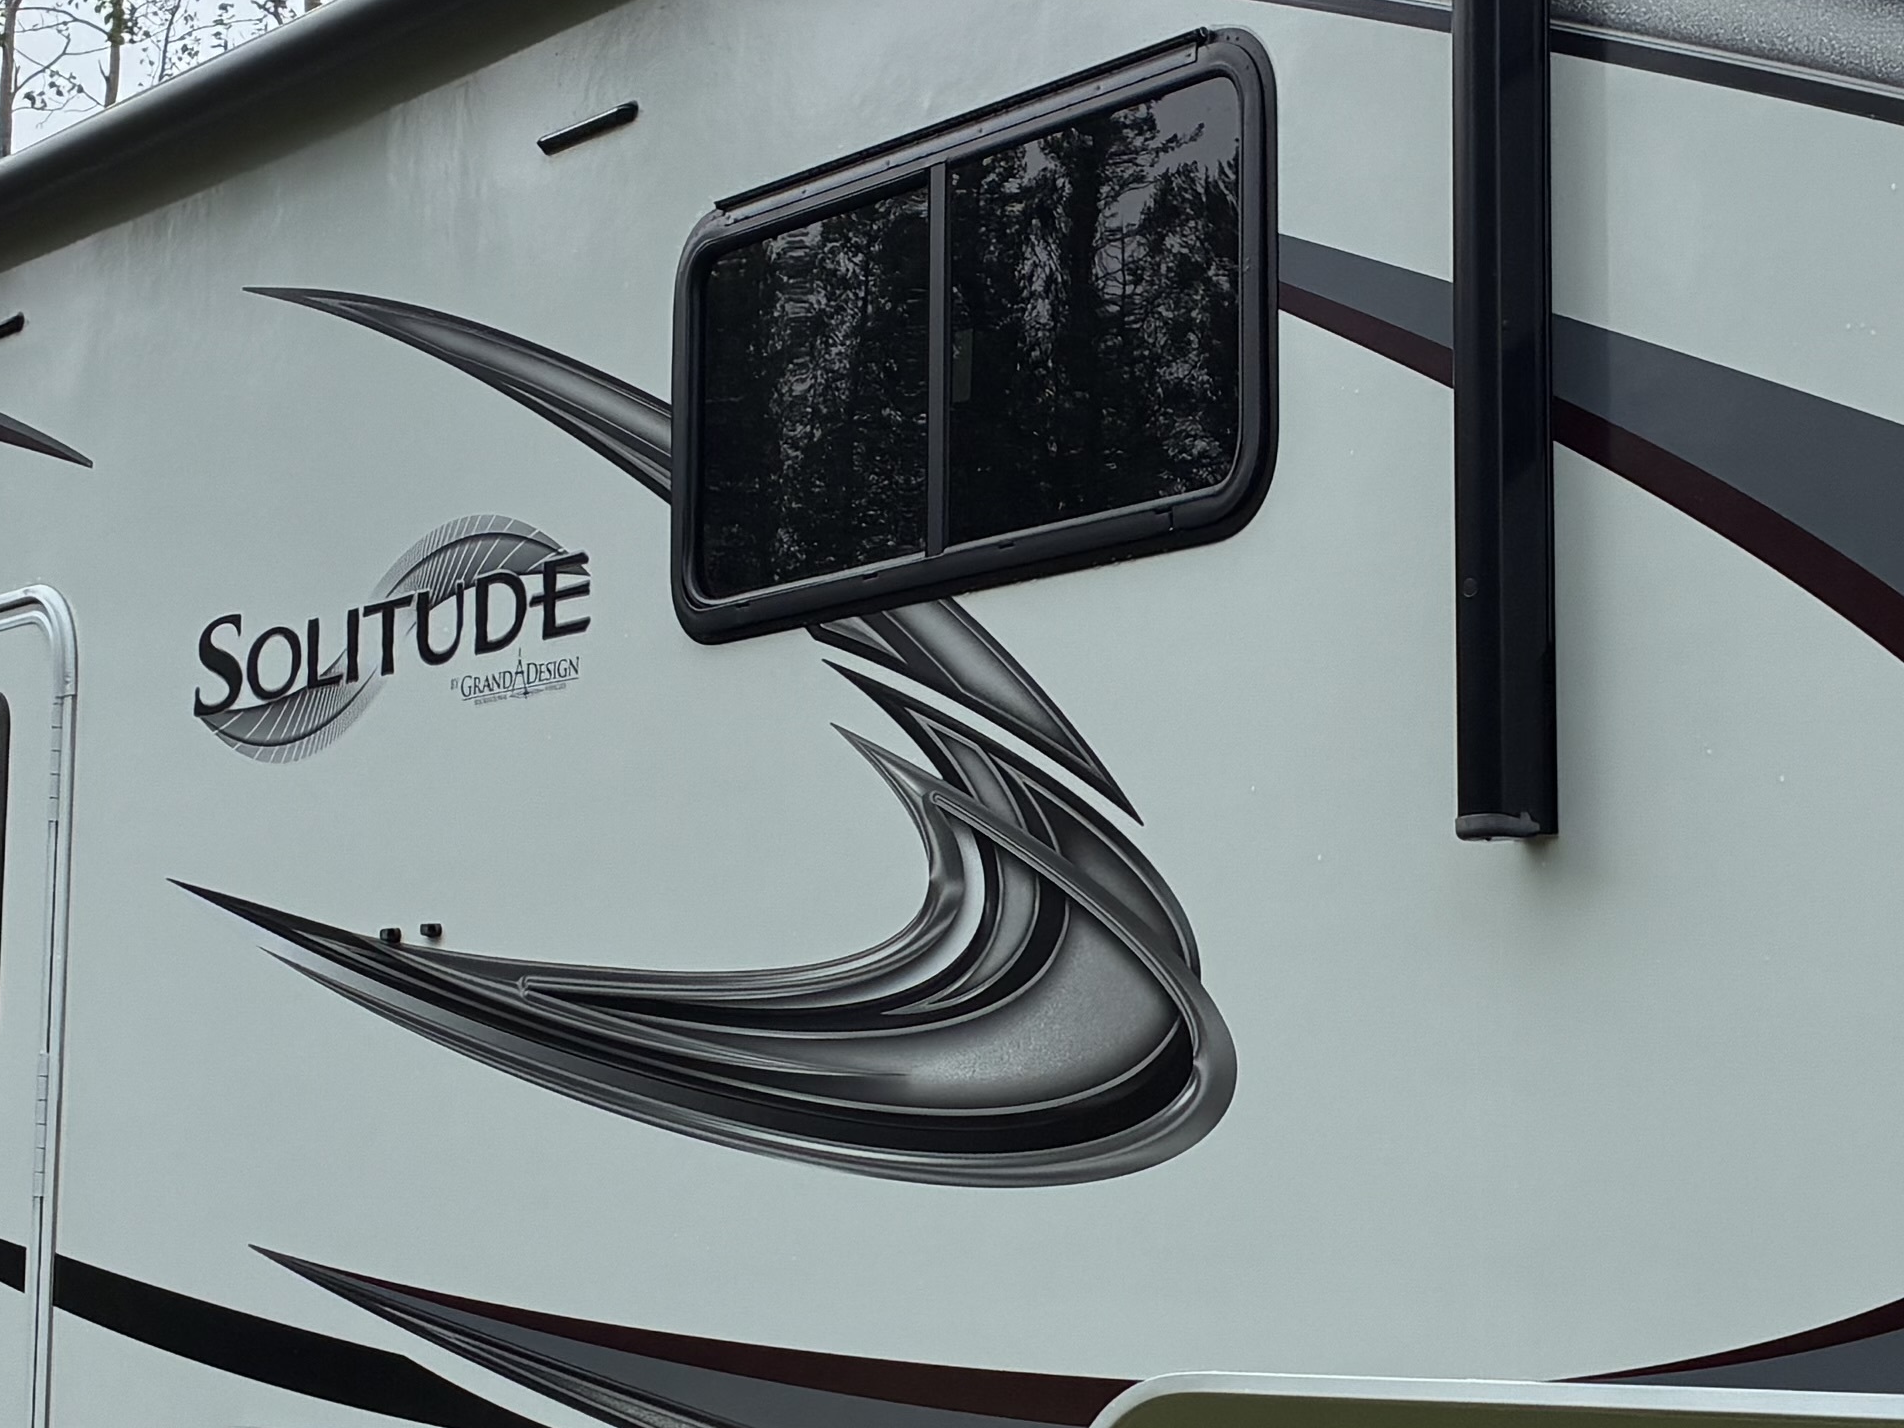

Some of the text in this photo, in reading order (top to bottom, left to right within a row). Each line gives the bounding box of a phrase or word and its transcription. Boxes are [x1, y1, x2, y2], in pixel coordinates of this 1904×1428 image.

[194, 550, 592, 718] SOLITUDE
[460, 670, 513, 698] GRAND
[526, 656, 580, 685] DESIGN
